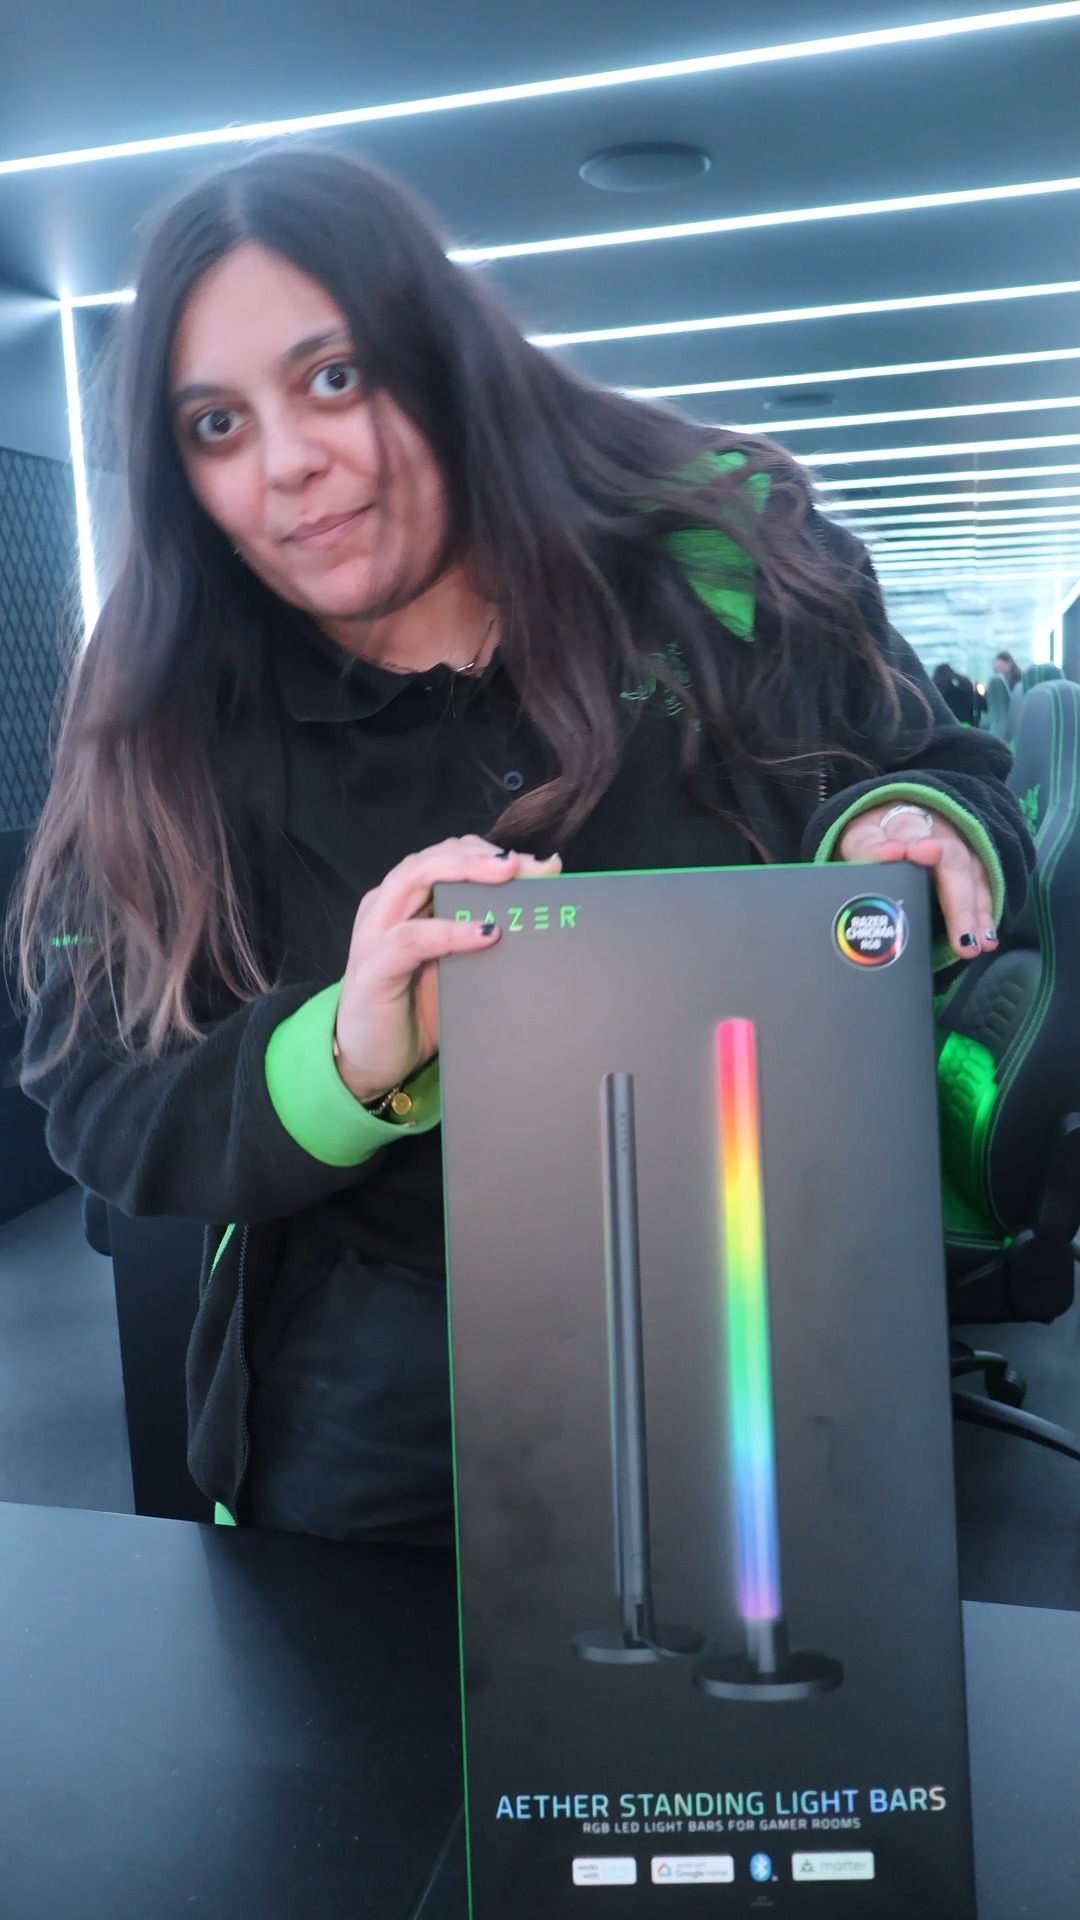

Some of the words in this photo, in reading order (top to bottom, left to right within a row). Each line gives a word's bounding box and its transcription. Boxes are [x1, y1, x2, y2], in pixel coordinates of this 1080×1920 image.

[496, 1794, 609, 1820] AETHER
[619, 1791, 764, 1818] STANDING
[775, 1789, 860, 1815] LIGHT
[869, 1785, 947, 1812] BARS
[582, 1821, 610, 1834] RGB
[614, 1821, 640, 1834] LED
[644, 1820, 682, 1833] LIGHT
[687, 1819, 724, 1832] BARS
[728, 1819, 755, 1832] FOR
[759, 1817, 807, 1831] GAMER
[811, 1817, 861, 1830] ROOMS
[820, 1860, 867, 1872] matter
